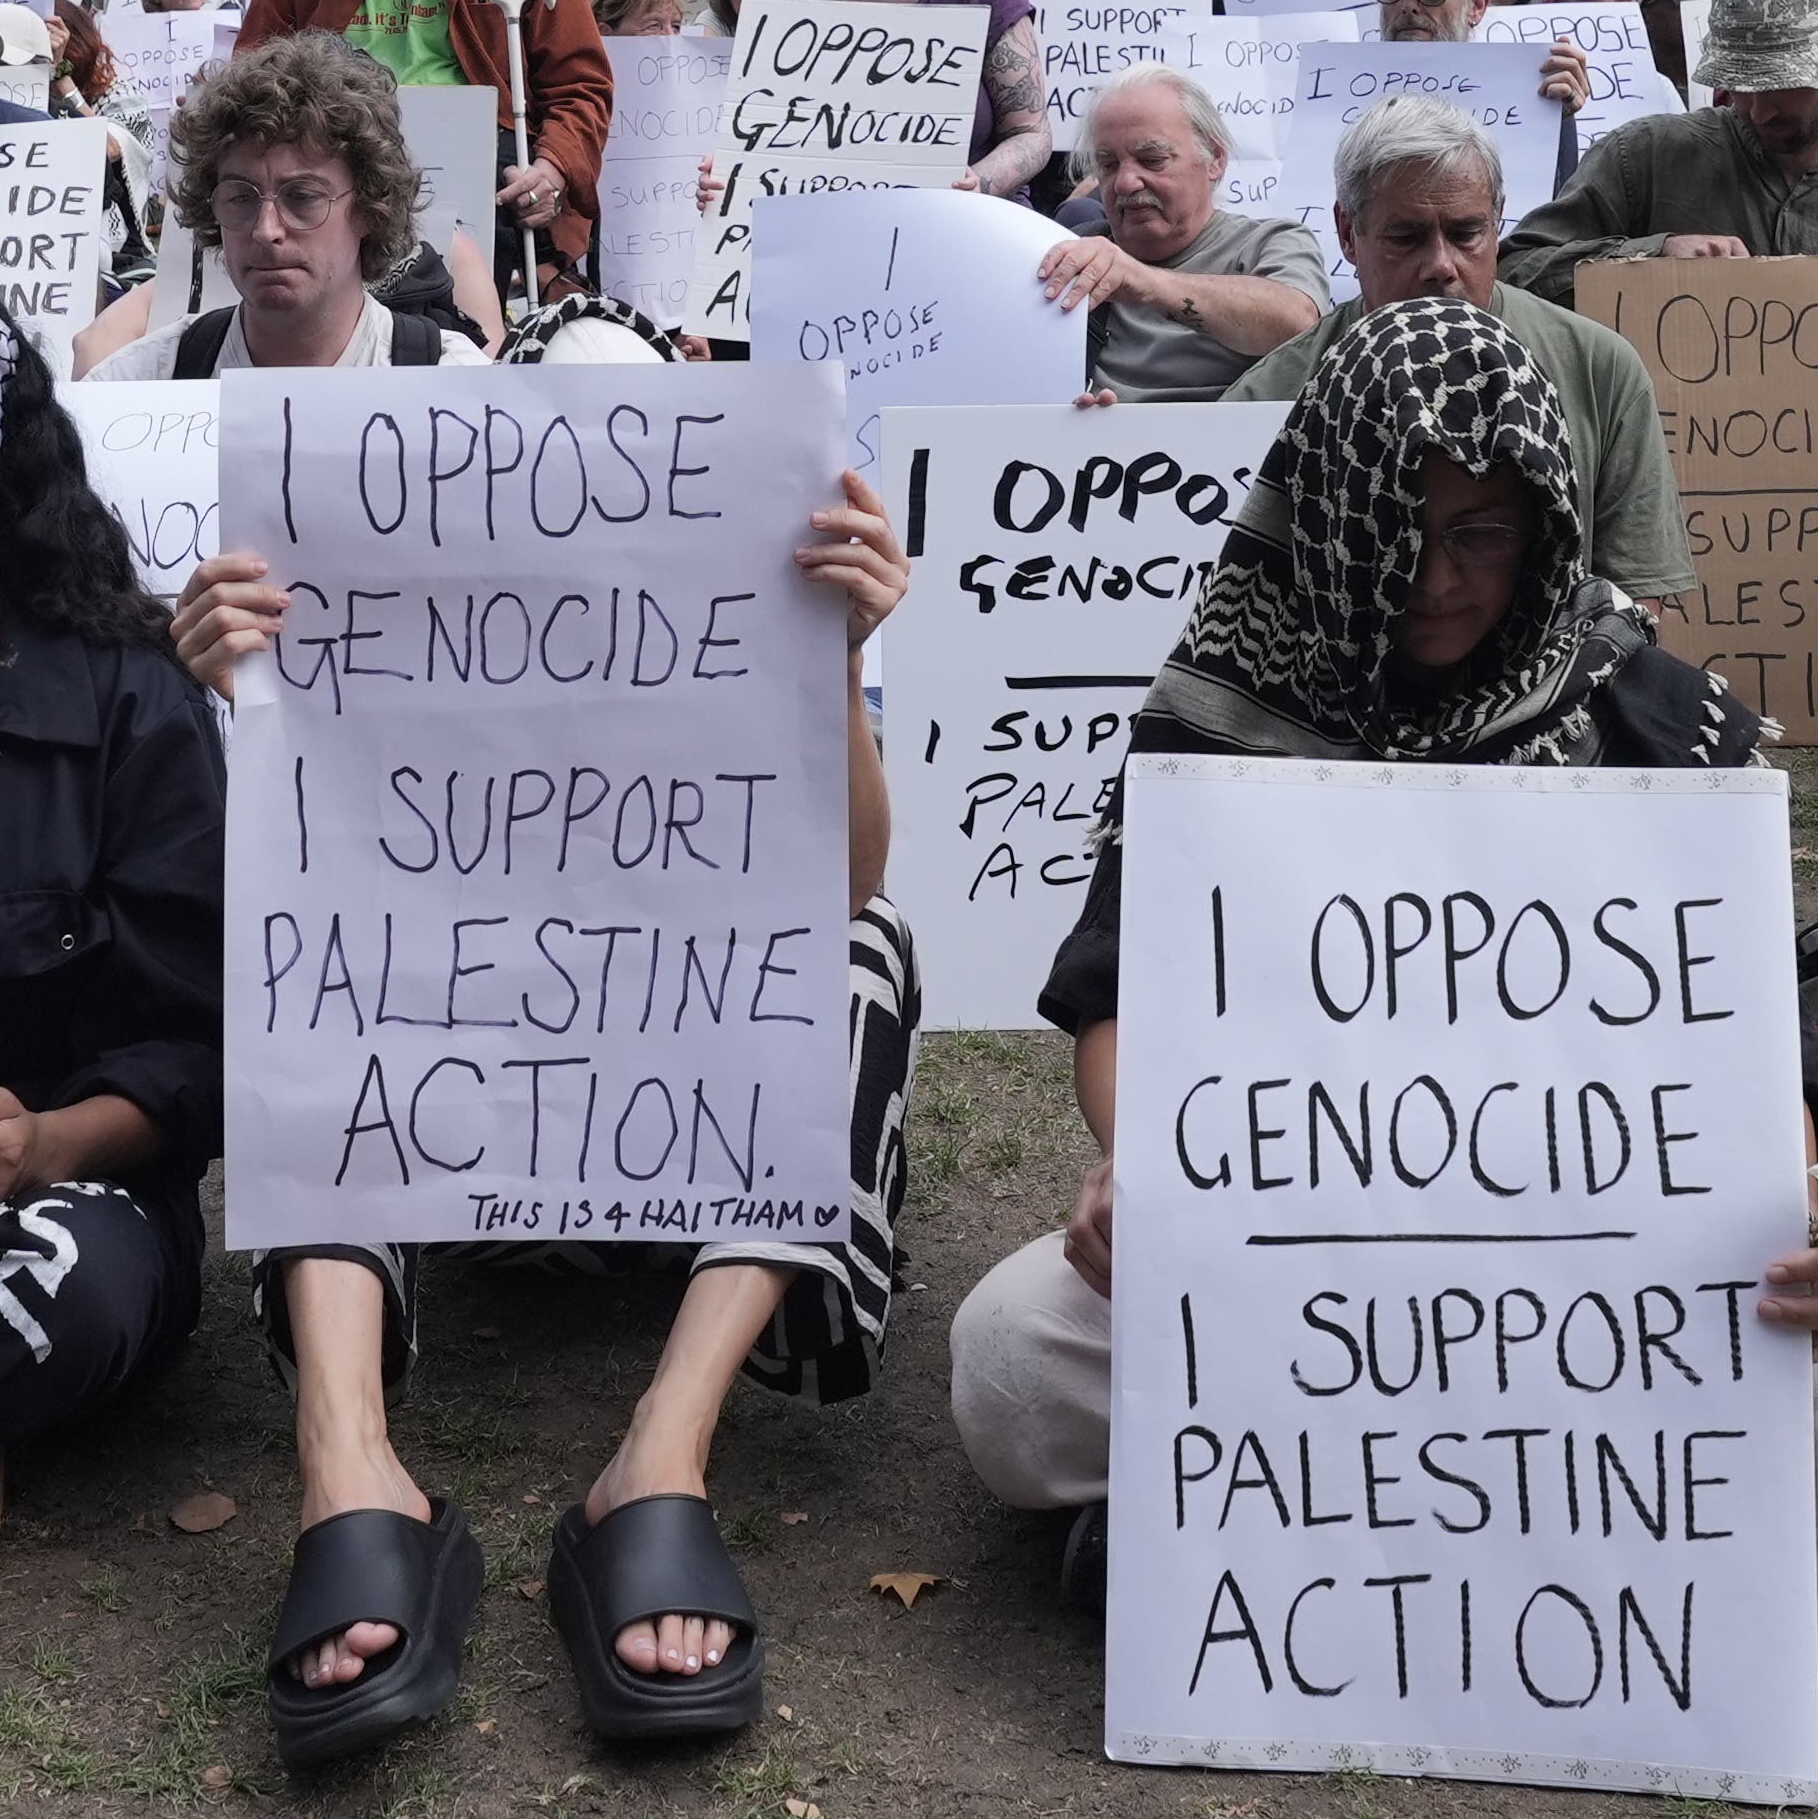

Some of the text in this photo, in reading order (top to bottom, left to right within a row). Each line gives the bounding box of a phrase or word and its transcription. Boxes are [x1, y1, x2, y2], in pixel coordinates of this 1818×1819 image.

[165, 19, 178, 42] I
[739, 14, 984, 88] I OPPOSE
[1038, 6, 1045, 36] I
[1186, 33, 1203, 69] I
[123, 45, 204, 68] OPPOSE
[637, 54, 730, 86] OPPOSE
[1307, 68, 1482, 101] I OPPOSE
[731, 88, 966, 152] GENOCIDE
[719, 163, 743, 218] I
[885, 227, 899, 291] I
[798, 300, 940, 362] OPPOSE
[282, 396, 299, 545] I
[358, 402, 725, 549] OPPOSE
[906, 448, 930, 558] I
[274, 580, 758, 716] GENOCIDE
[924, 718, 943, 766] I
[293, 756, 778, 875] I SUPPORT
[263, 910, 815, 1037] PALESTINE
[1212, 885, 1735, 1026] I OPPOSE
[335, 1052, 777, 1194] ACTION.
[1174, 1073, 1714, 1198] GENOCIDE
[469, 1192, 810, 1233] THIS IS 4 HAITHAM
[1180, 1279, 1760, 1409] I SUPPORT
[1171, 1424, 1749, 1542] PALESTINE
[1188, 1568, 1697, 1712] ACTION
